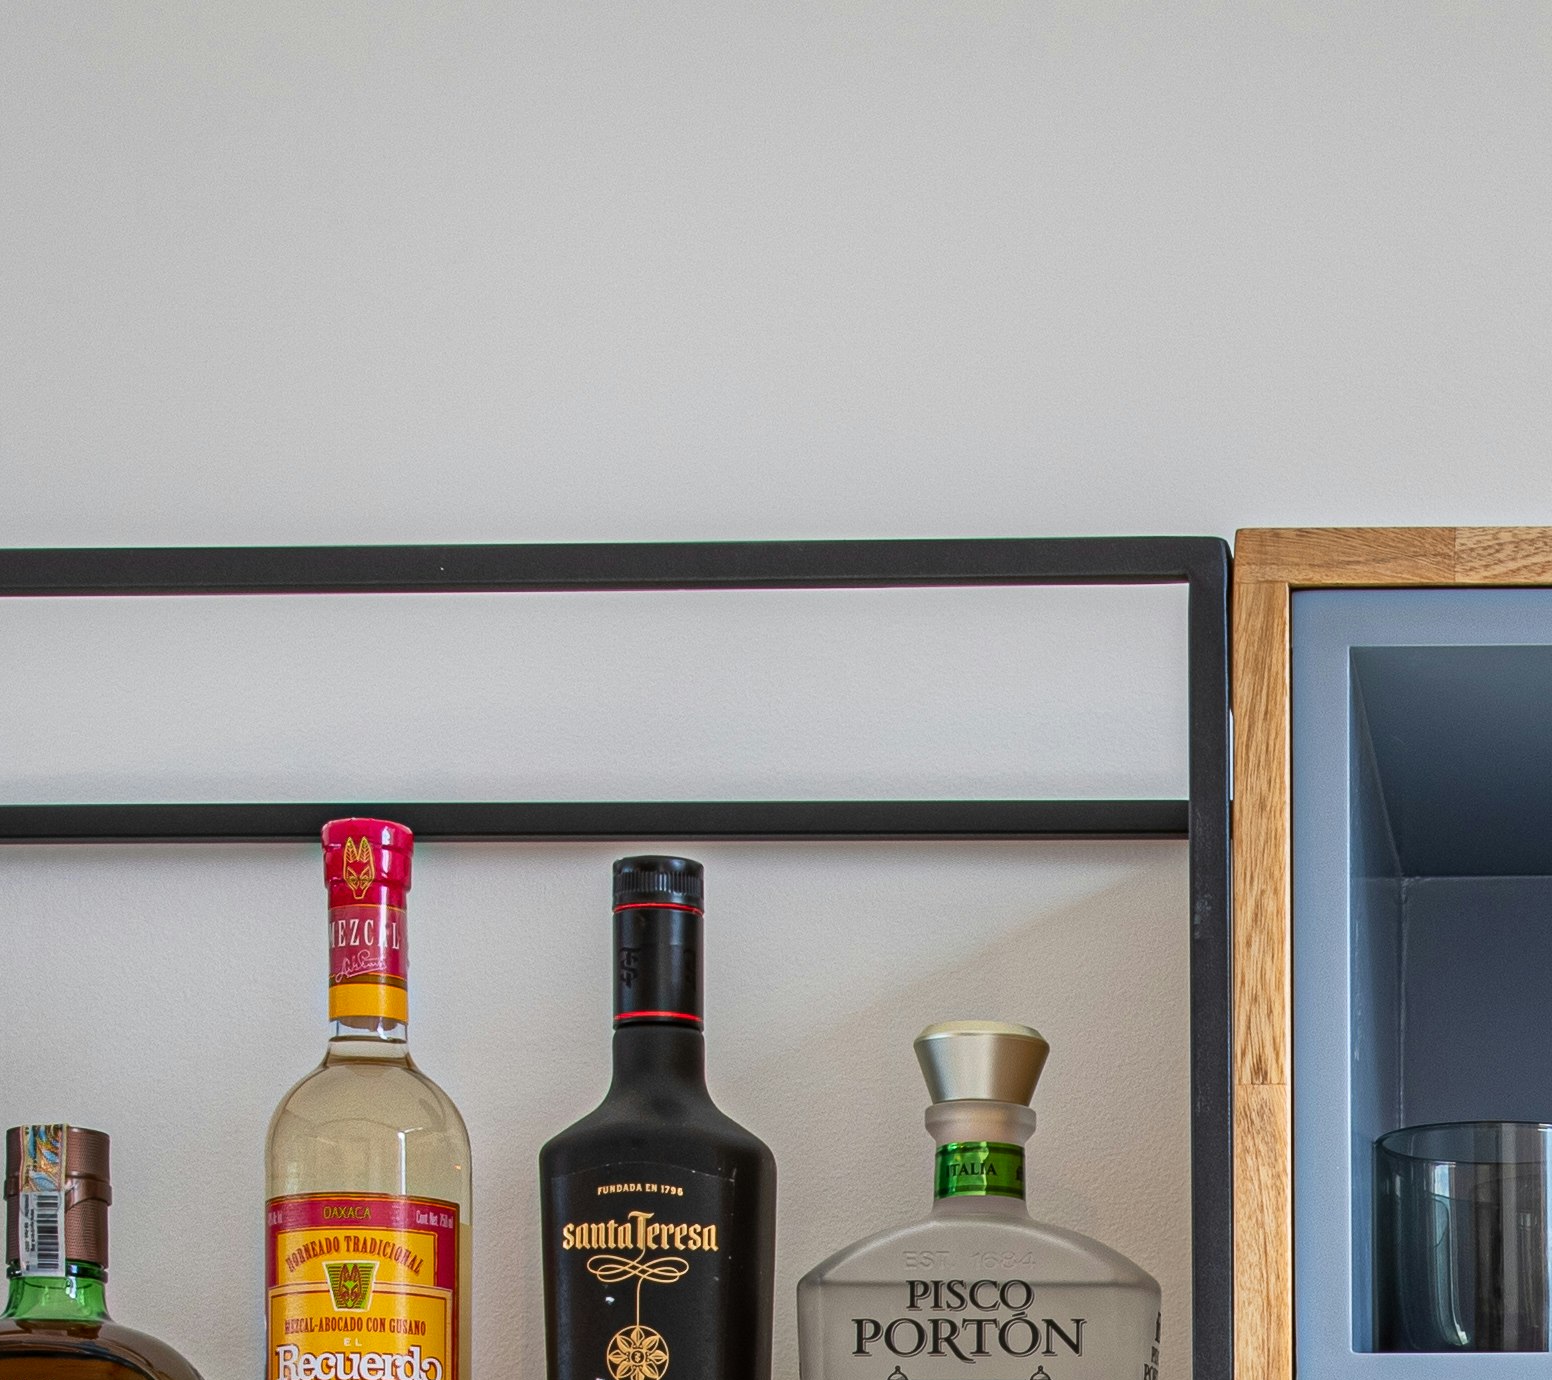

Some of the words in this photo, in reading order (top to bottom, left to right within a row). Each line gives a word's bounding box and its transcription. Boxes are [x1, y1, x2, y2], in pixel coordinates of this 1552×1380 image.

[946, 1162, 998, 1178] ITALIA
[597, 1183, 643, 1196] FUNDADA
[645, 1183, 658, 1192] EN
[660, 1185, 684, 1197] 1796
[323, 1205, 371, 1220] OAXACA
[284, 1235, 340, 1273] HORNEADO
[344, 1235, 425, 1275] TRADICIONAL
[905, 1279, 1035, 1312] PISCO
[366, 1318, 386, 1333] CON
[389, 1318, 426, 1336] GUSANO
[851, 1311, 1088, 1364] PORTÓN
